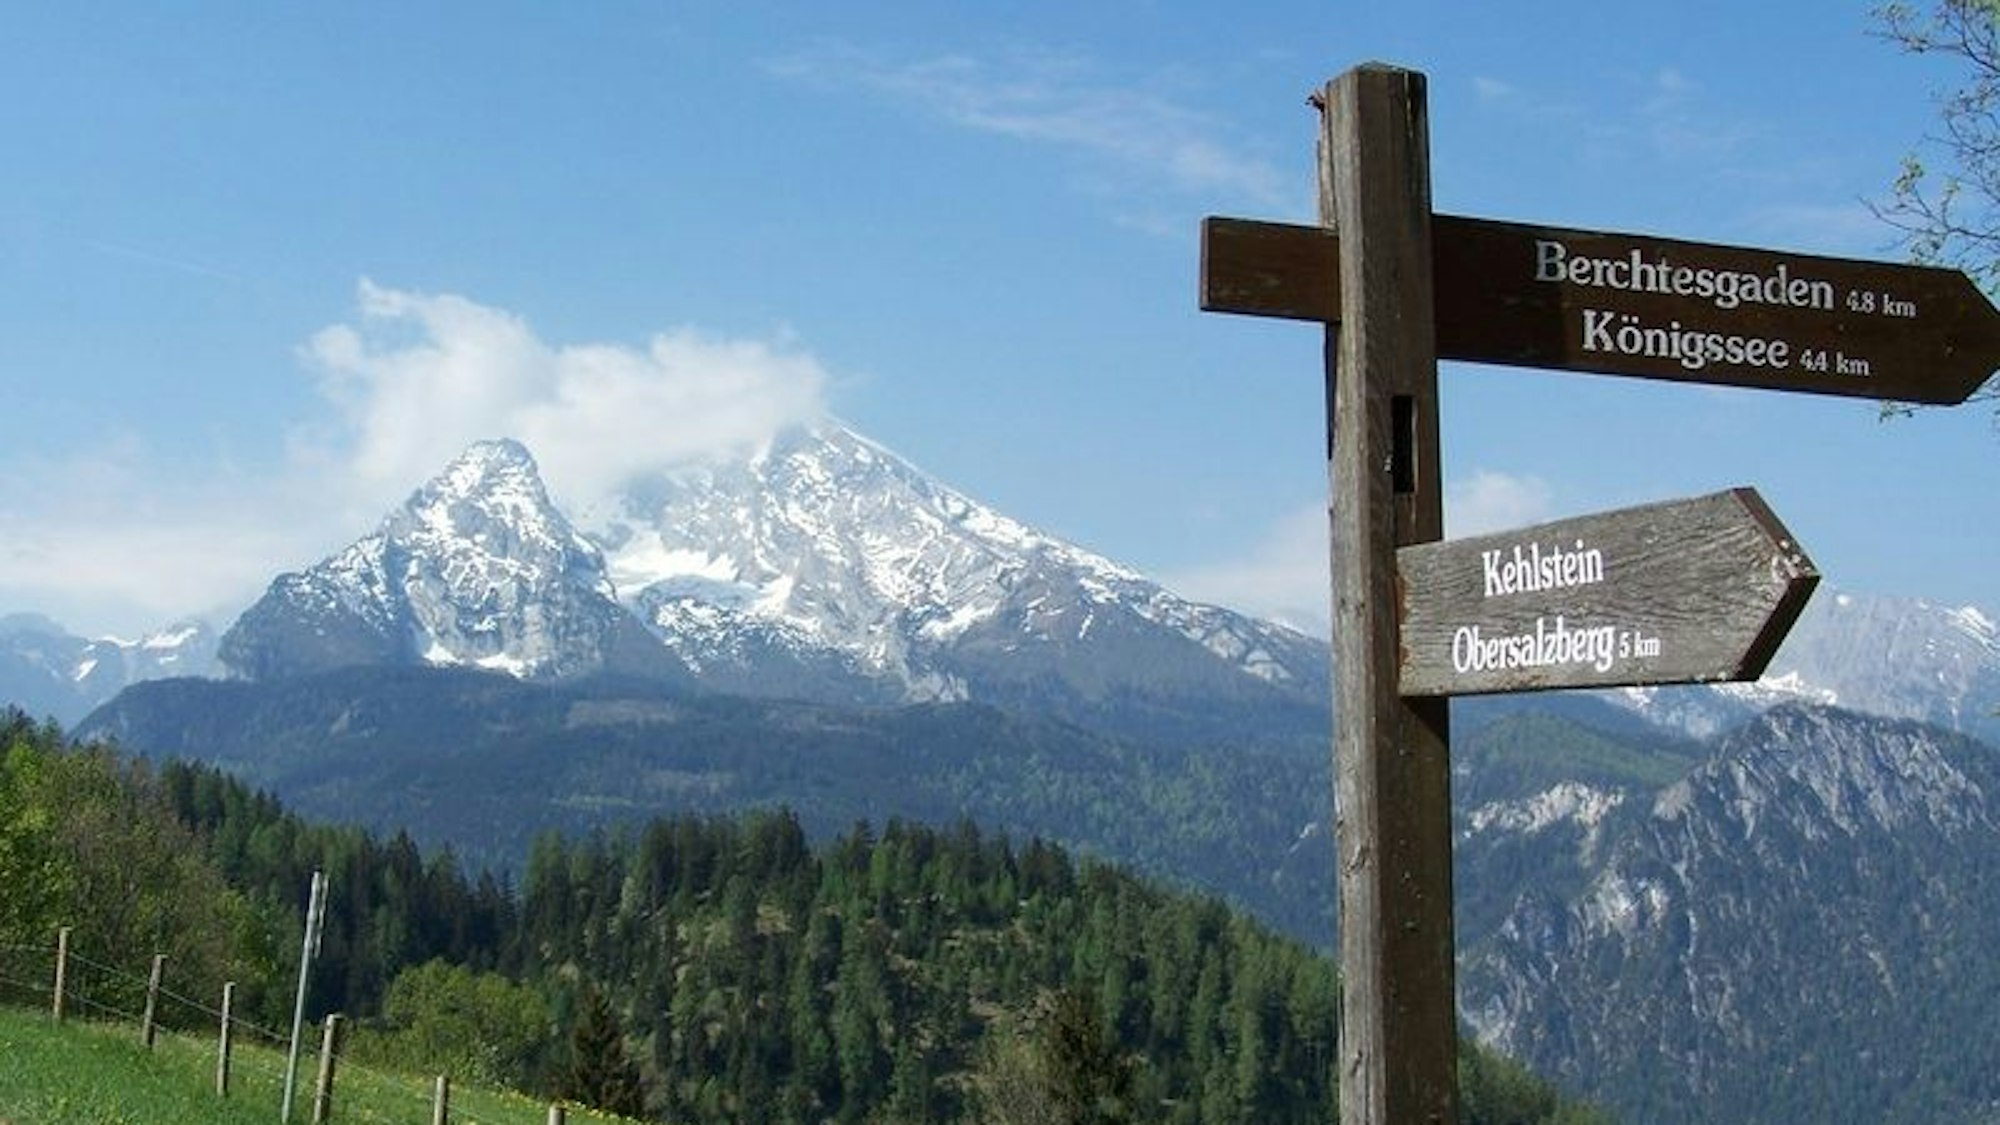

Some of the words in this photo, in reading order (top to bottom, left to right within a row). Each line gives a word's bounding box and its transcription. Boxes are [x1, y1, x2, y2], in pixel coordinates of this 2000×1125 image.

[1535, 240, 1834, 310] Berchtesgaden
[1882, 293, 1917, 318] km
[1582, 308, 1789, 369] Königssee
[1836, 351, 1870, 376] km
[1482, 539, 1604, 597] Kehlstein
[1453, 616, 1616, 673] Obersalzberg
[1618, 634, 1631, 658] 5
[1634, 632, 1661, 657] km
